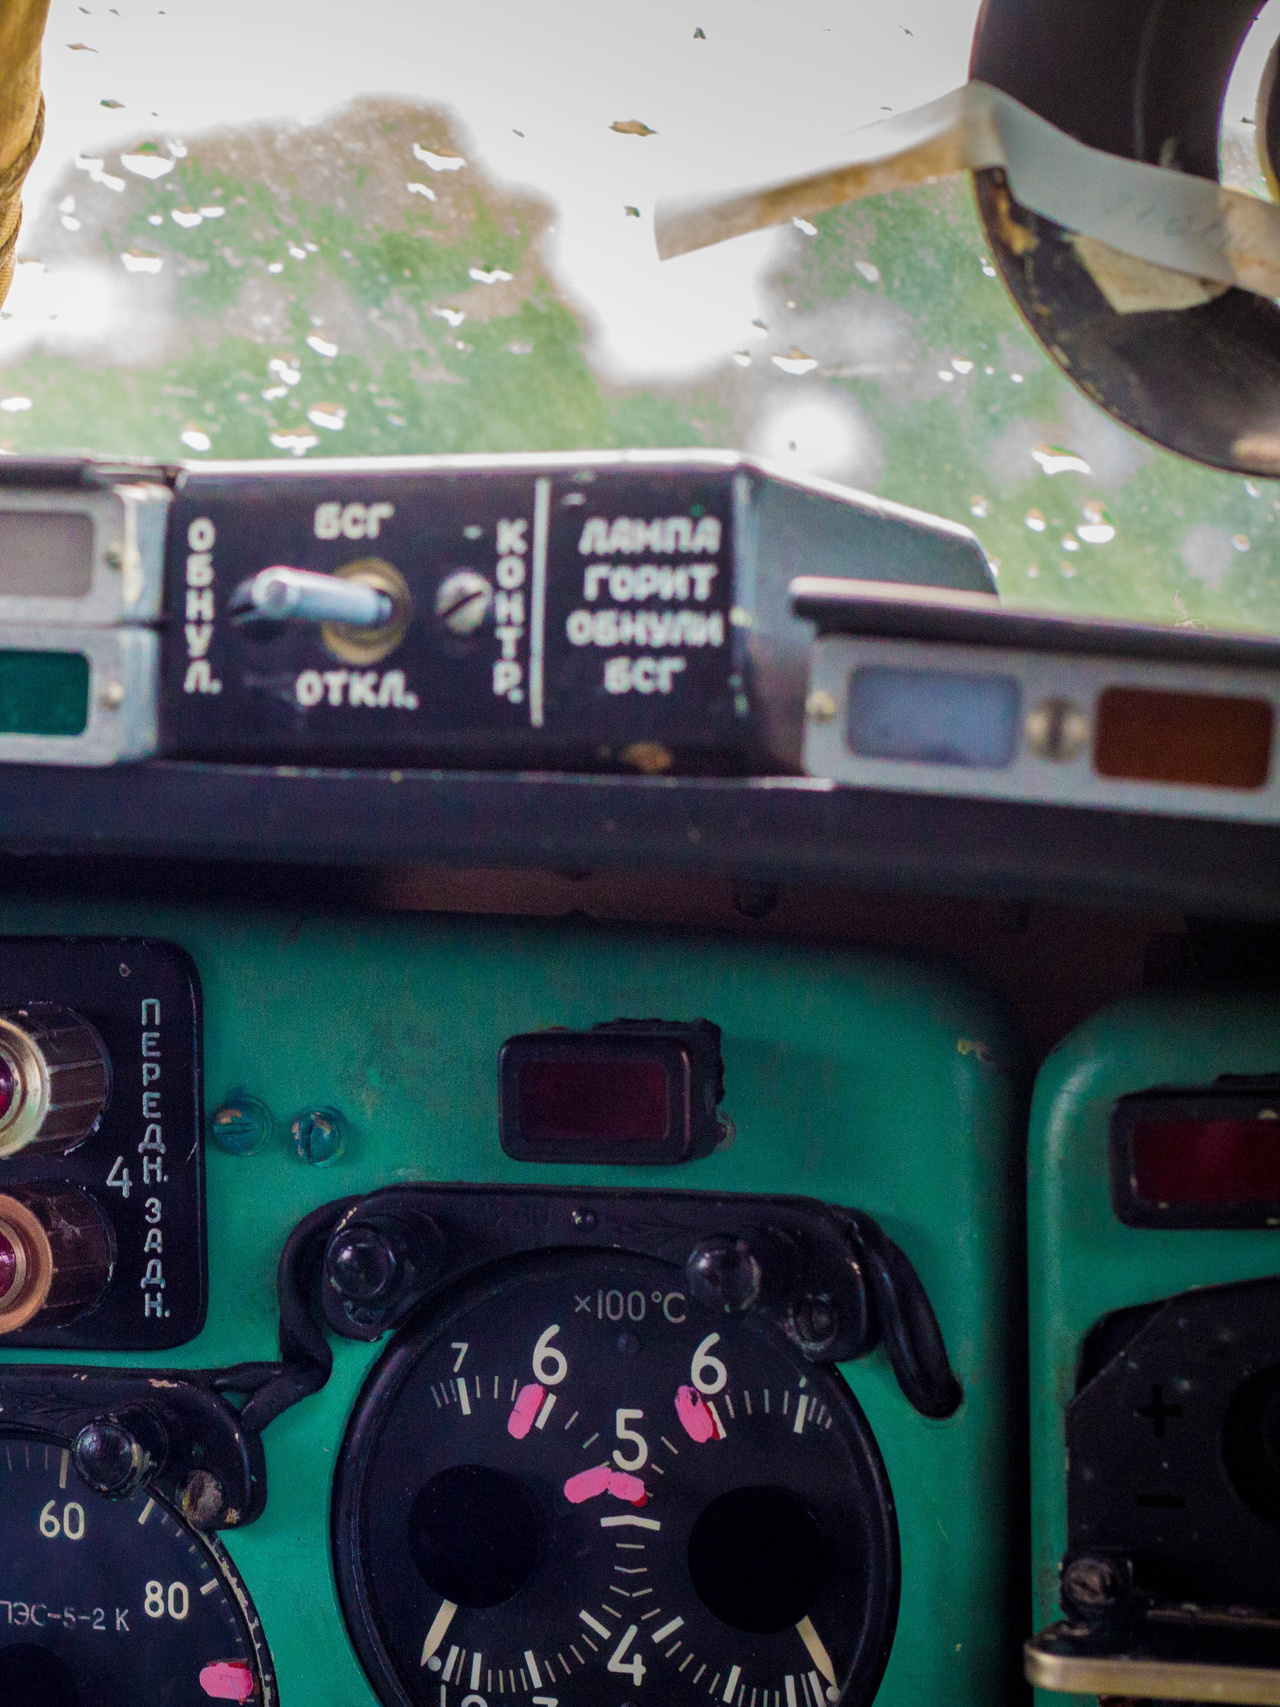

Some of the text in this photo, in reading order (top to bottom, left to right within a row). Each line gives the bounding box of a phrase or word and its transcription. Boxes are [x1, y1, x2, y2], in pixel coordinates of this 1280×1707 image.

[313, 503, 394, 540] БСГ
[578, 517, 721, 554] ЛАМПА
[583, 564, 718, 602] ГОРИТ
[184, 518, 222, 695] ОБНУЛ.
[492, 518, 527, 703] КОНТР.
[566, 609, 724, 648] ОБНУЛИ
[295, 670, 419, 710] ОТКЛ.
[604, 657, 686, 695] БСГ
[138, 998, 168, 1183] ПЕРЕДН.
[106, 1156, 132, 1198] 4
[140, 1199, 169, 1318] ЗАДН.
[451, 1342, 470, 1373] 7
[531, 1323, 568, 1385] 6
[690, 1332, 728, 1395] 6
[612, 1408, 649, 1471] 5
[39, 1499, 86, 1540] 60
[143, 1580, 190, 1621] 80
[606, 1623, 647, 1686] 4
